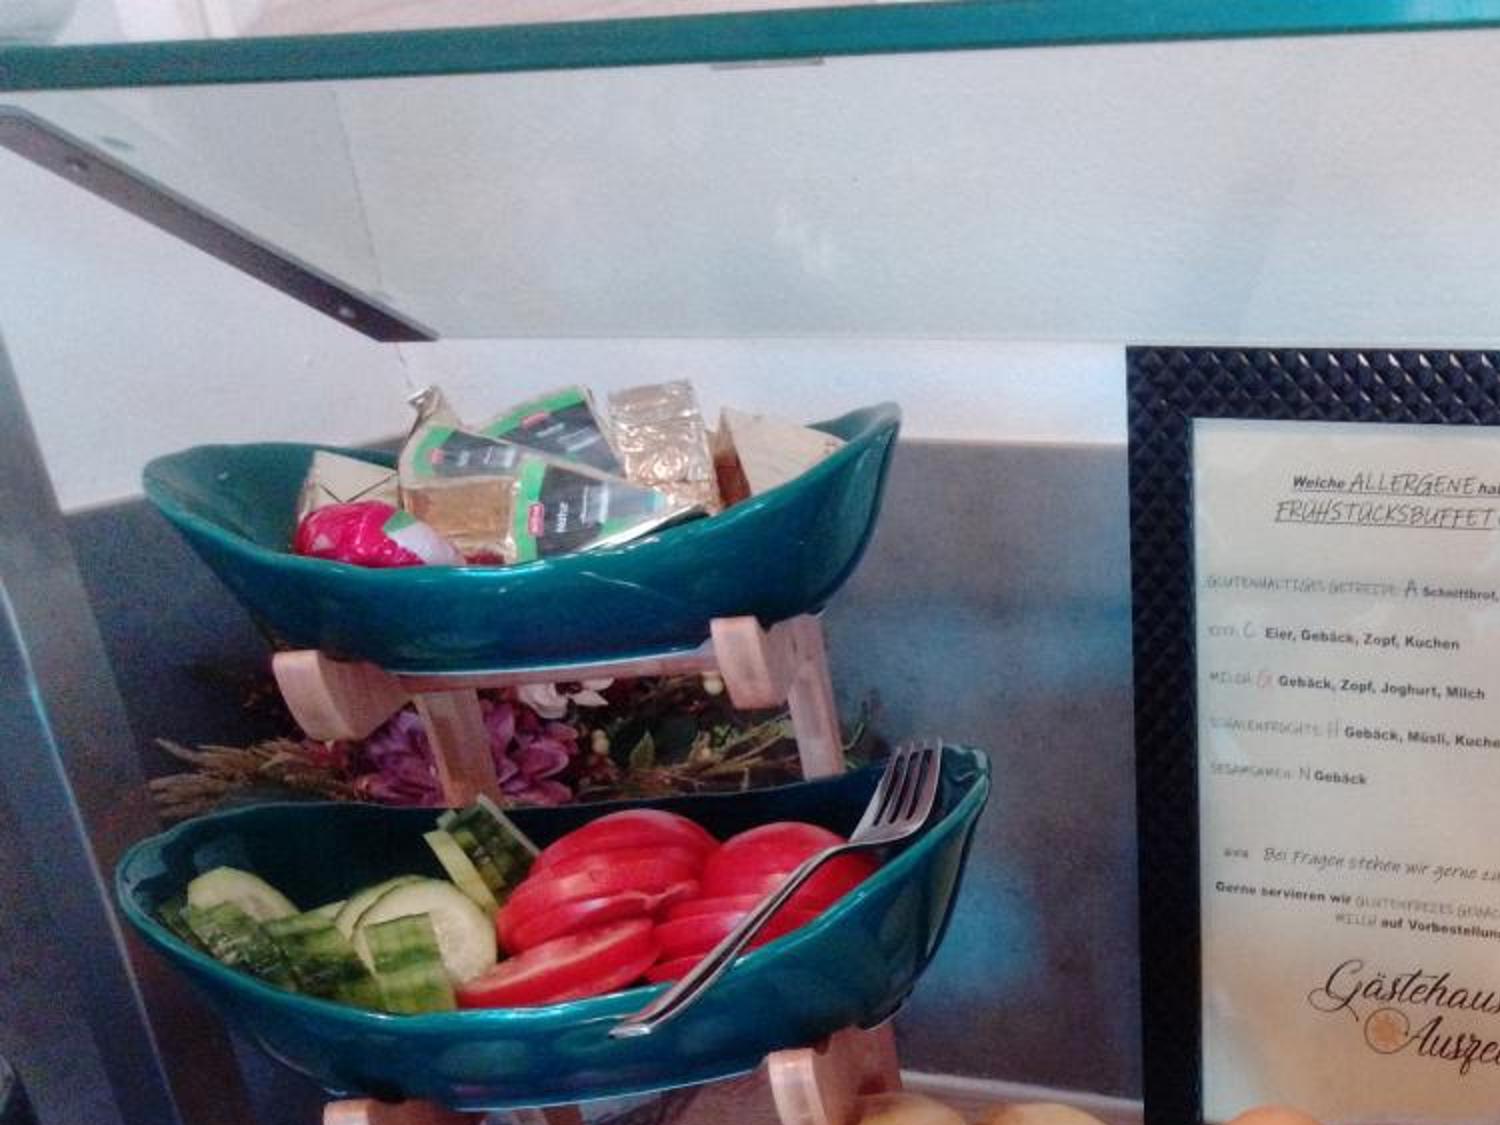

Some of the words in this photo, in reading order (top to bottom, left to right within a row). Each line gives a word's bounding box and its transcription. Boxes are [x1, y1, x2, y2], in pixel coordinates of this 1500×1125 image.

[1349, 471, 1476, 497] ALLERGENE
[1265, 626, 1297, 642] Eier,
[1301, 628, 1359, 647] Gebäck,
[1363, 632, 1400, 648] Zopf,
[1405, 635, 1461, 651] Kuchen
[1278, 674, 1337, 692] Gebäck,
[1340, 678, 1376, 696] Zopf,
[1380, 681, 1441, 699] Joghurt,
[1446, 684, 1486, 701] Milch
[1344, 725, 1403, 744] Gebäck,
[1407, 730, 1450, 747] Müsli,
[1313, 768, 1368, 785] Gebäck
[1264, 847, 1287, 862] Bei
[1293, 850, 1345, 872] Fragen
[1349, 855, 1401, 874] stehen
[1405, 862, 1429, 875] wir
[1432, 865, 1477, 883] gerne
[1215, 881, 1257, 895] Gerne
[1261, 886, 1326, 902] servieren
[1330, 894, 1353, 905] wir
[1381, 917, 1404, 929] auf
